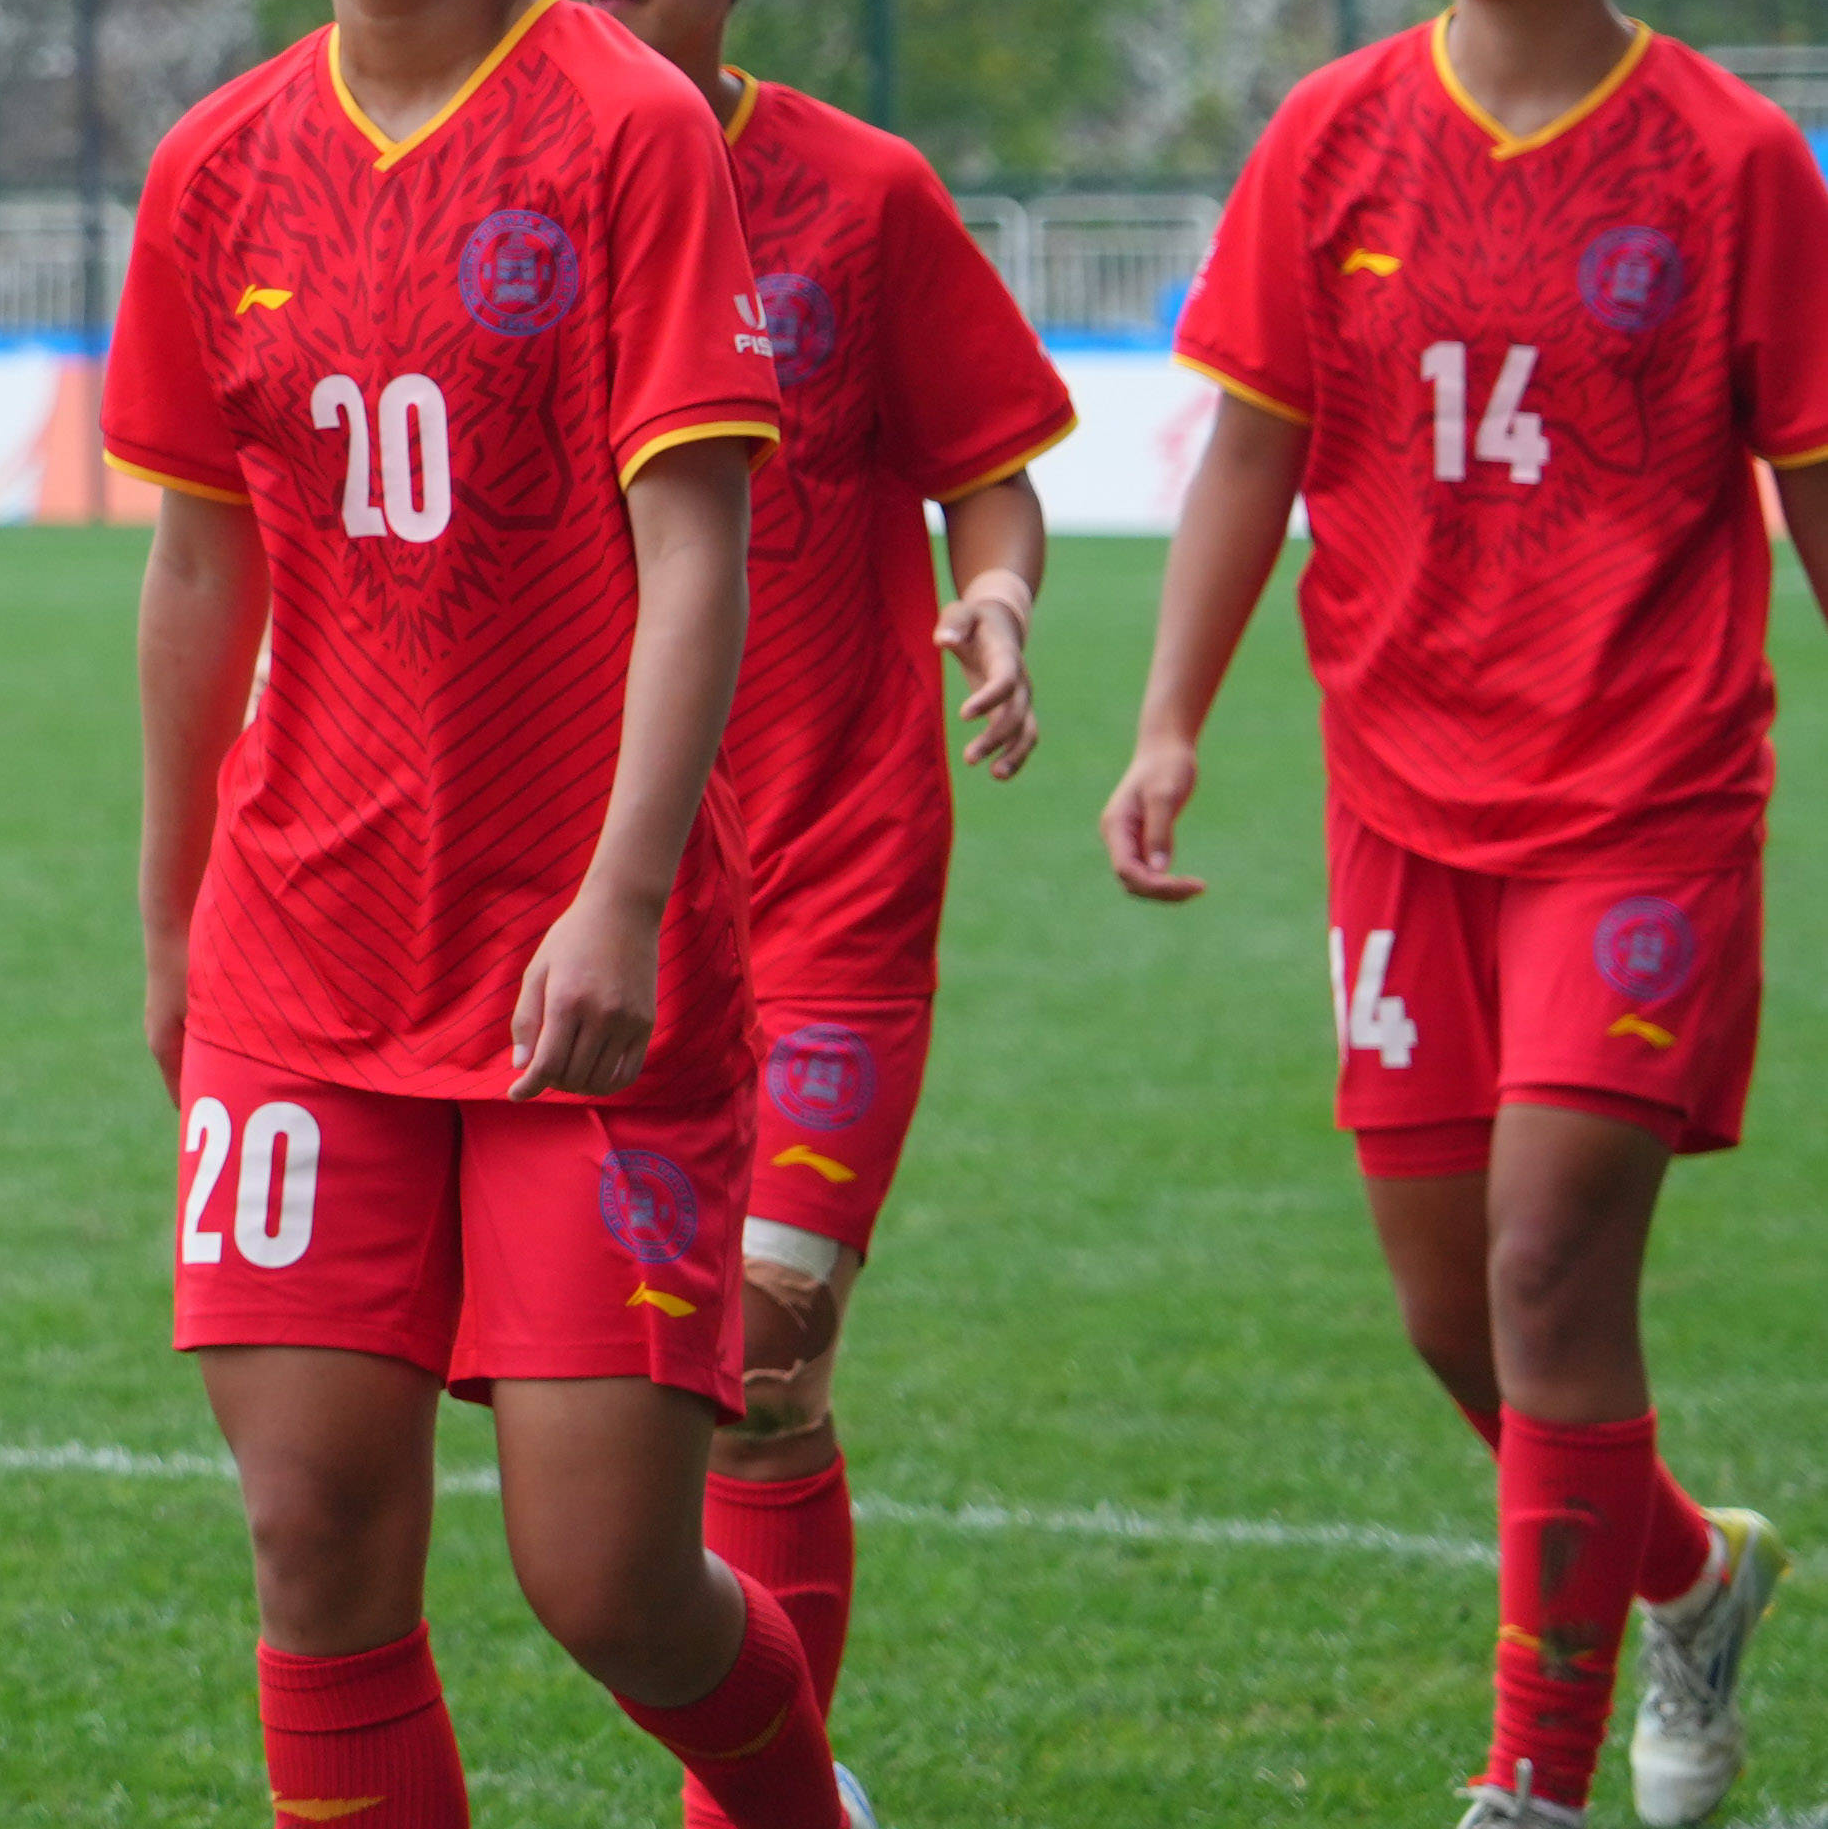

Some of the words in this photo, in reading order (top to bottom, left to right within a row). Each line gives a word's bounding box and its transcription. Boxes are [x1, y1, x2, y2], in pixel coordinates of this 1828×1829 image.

[734, 333, 774, 359] FIS
[1421, 341, 1549, 485] 14
[310, 372, 453, 544] 20
[1329, 925, 1418, 1069] 14
[182, 1096, 322, 1270] 20
